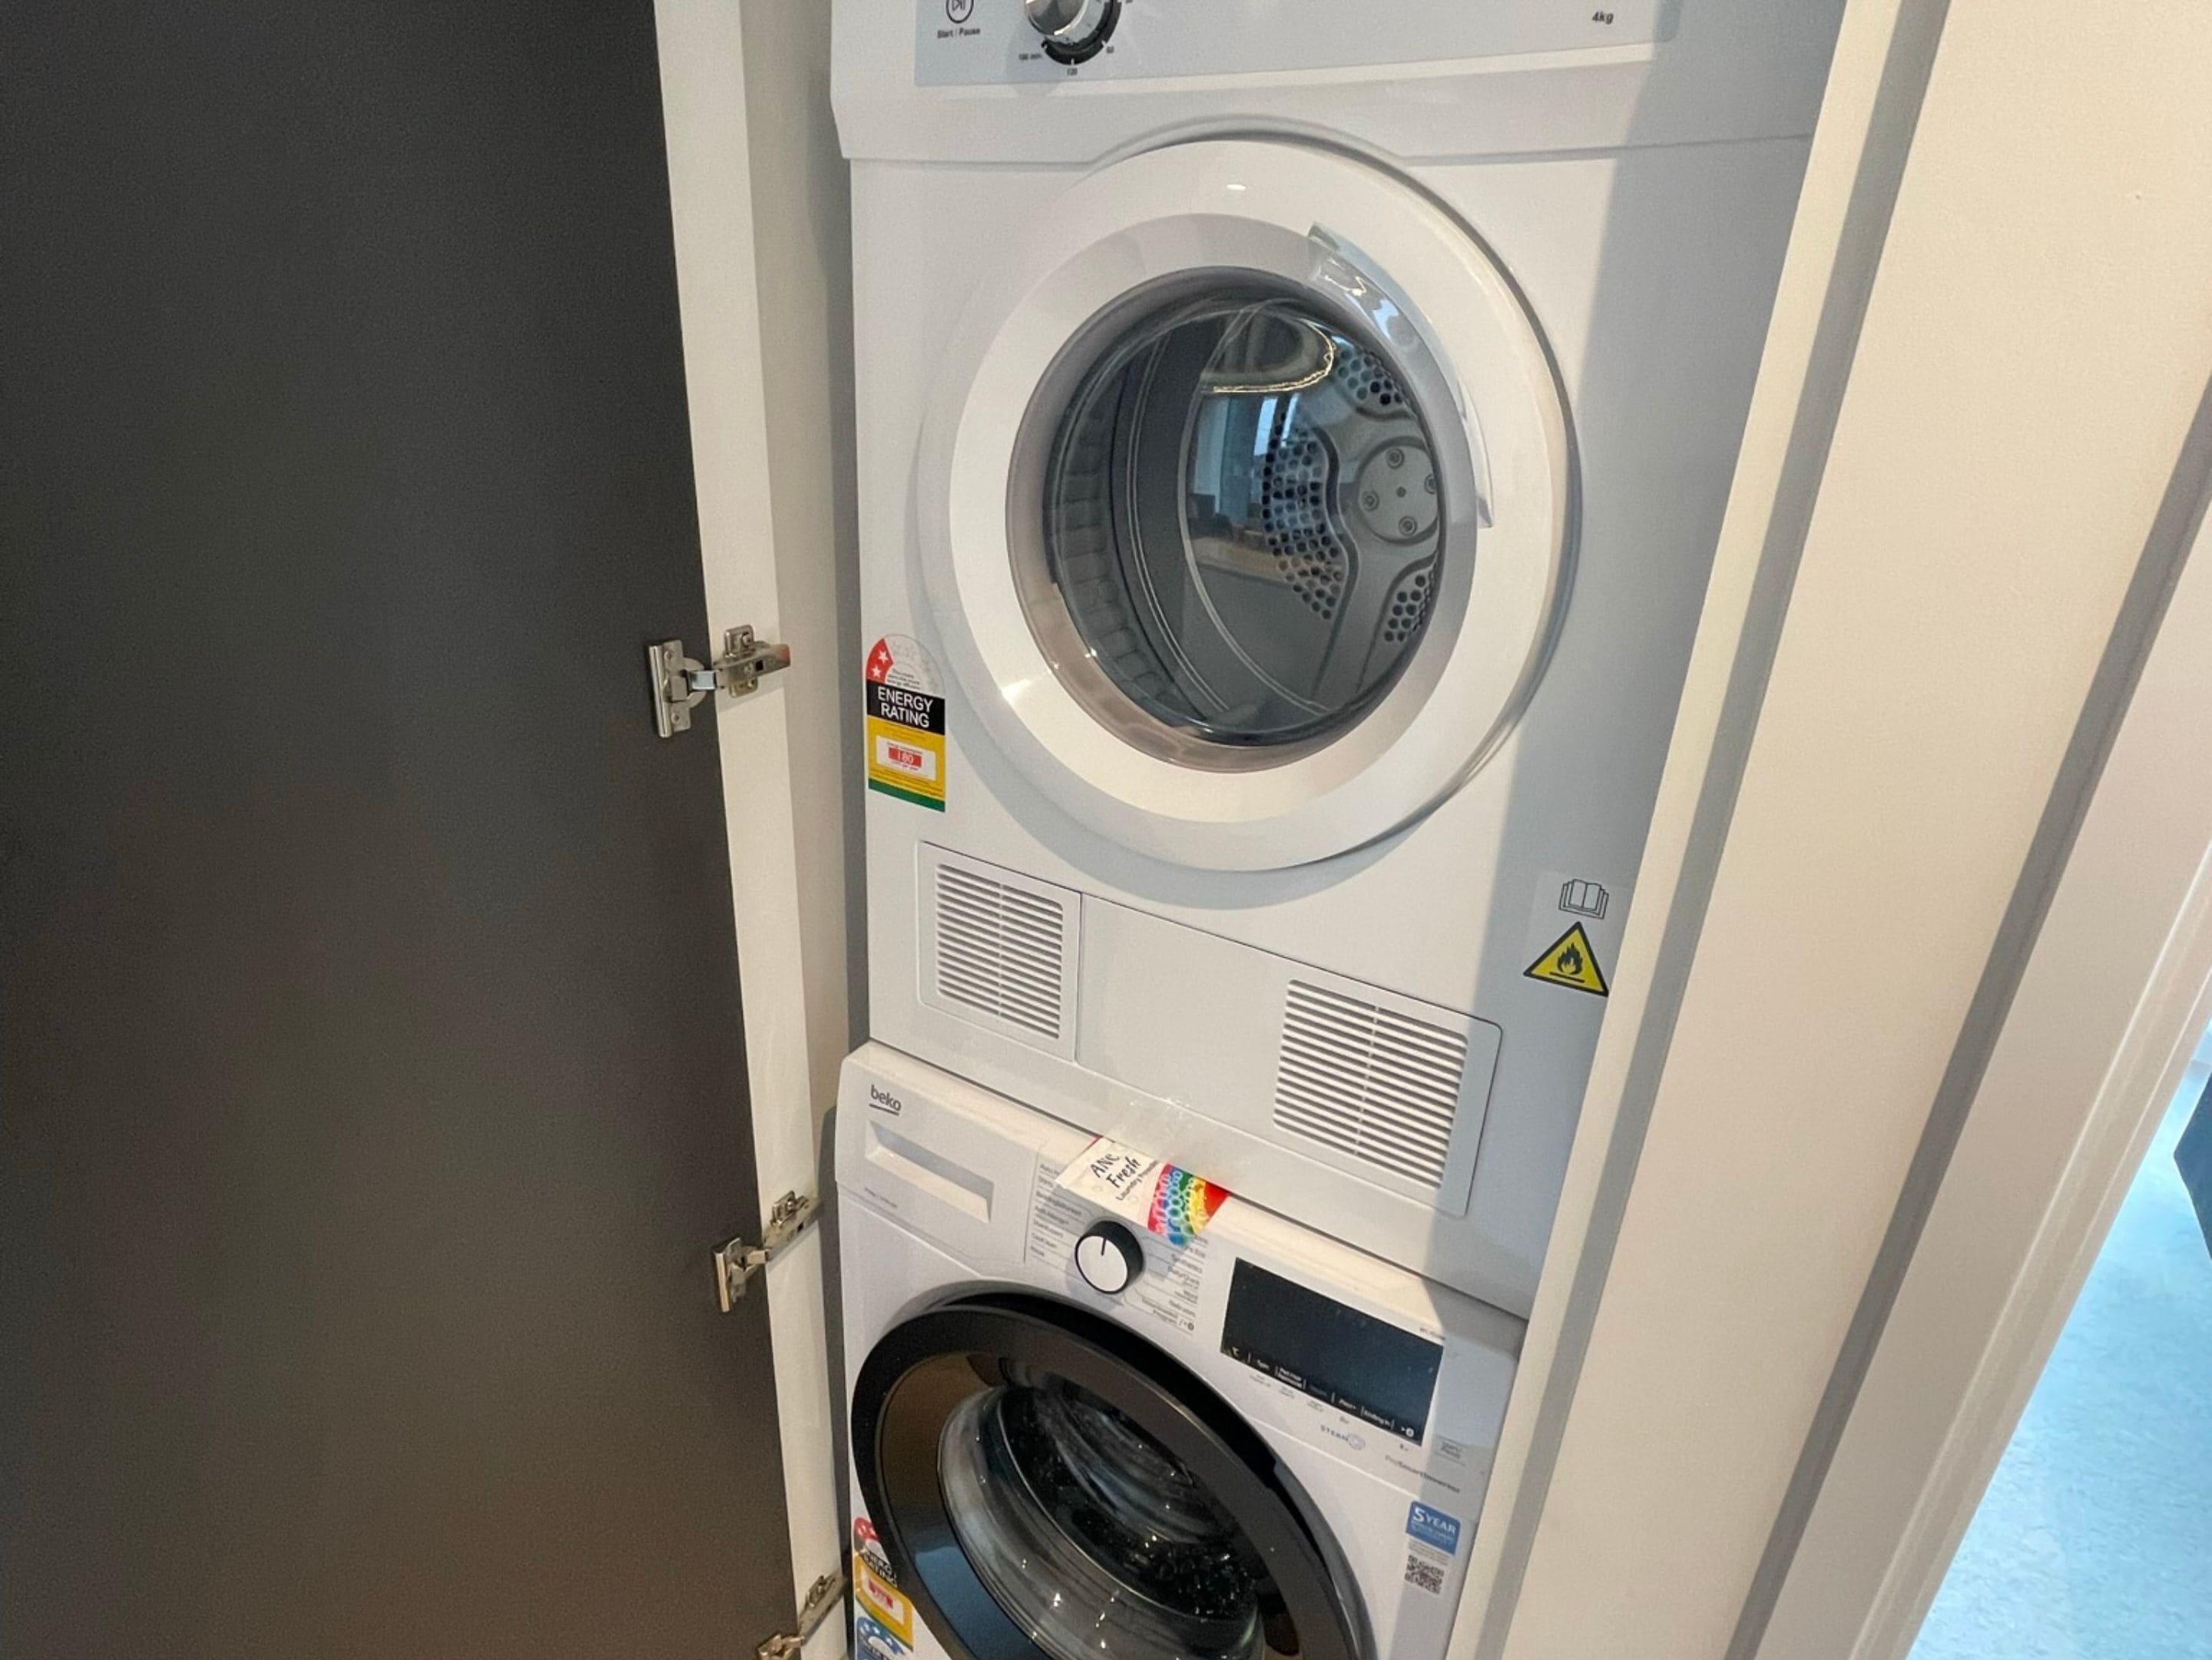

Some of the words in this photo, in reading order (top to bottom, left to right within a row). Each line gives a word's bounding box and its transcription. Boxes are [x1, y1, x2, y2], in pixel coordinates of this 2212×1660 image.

[1591, 11, 1614, 25] 4kg
[936, 28, 954, 38] Start
[958, 27, 981, 36] Pause
[878, 686, 933, 713] ENERGY
[881, 703, 929, 728] RATING
[870, 1084, 902, 1112] beko
[1106, 1156, 1141, 1188] Fresh
[1412, 1506, 1426, 1522] 5
[1425, 1512, 1458, 1536] YEAR
